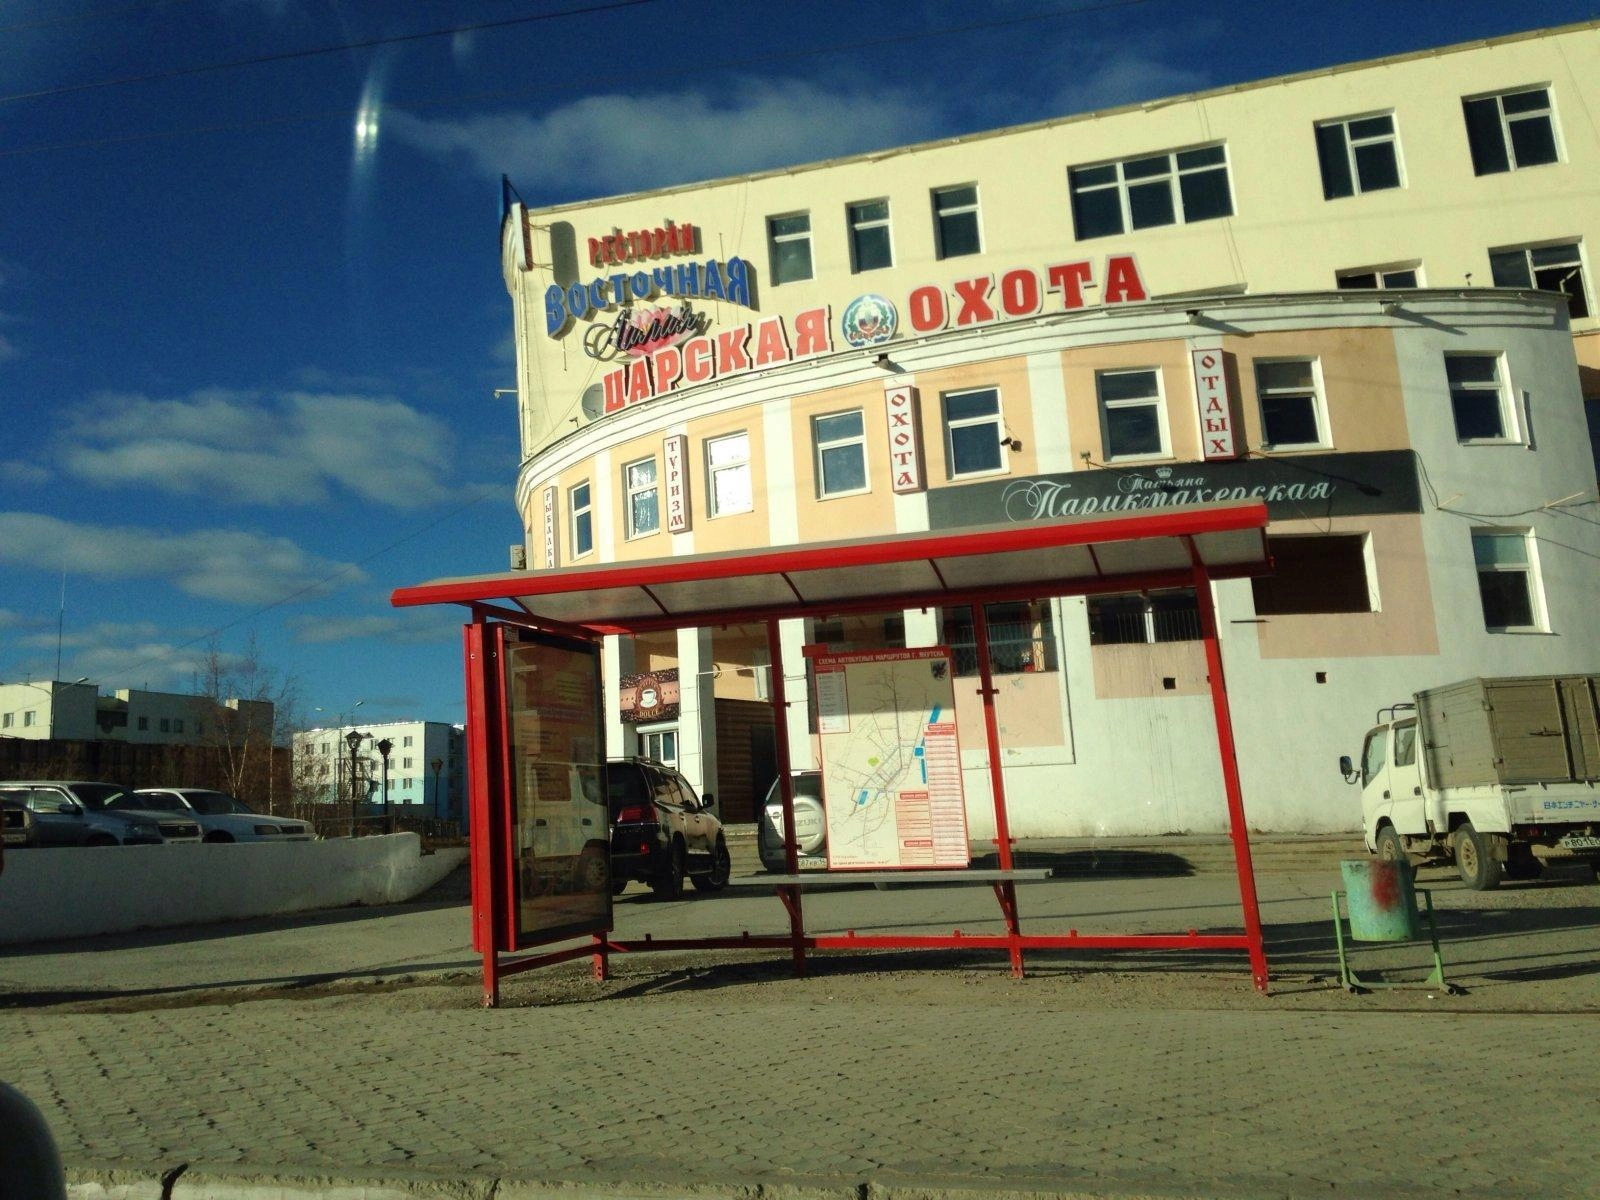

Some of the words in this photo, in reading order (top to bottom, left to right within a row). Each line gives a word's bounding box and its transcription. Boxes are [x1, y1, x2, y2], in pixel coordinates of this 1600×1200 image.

[588, 222, 695, 266] РЕСТОРАН
[544, 256, 752, 338] ВОСТОЧНАЯ
[602, 307, 832, 414] ЦАРСКАЯ
[907, 253, 1149, 334] ОХОТА
[890, 393, 914, 486] ОХОТА
[1201, 354, 1227, 454] ОТДЫХ
[667, 440, 684, 527] ТУРИЗМ
[1002, 479, 1336, 523] Парикмахерская
[818, 657, 837, 665] СХЕМА
[875, 652, 911, 661] МАРШРУТОВ
